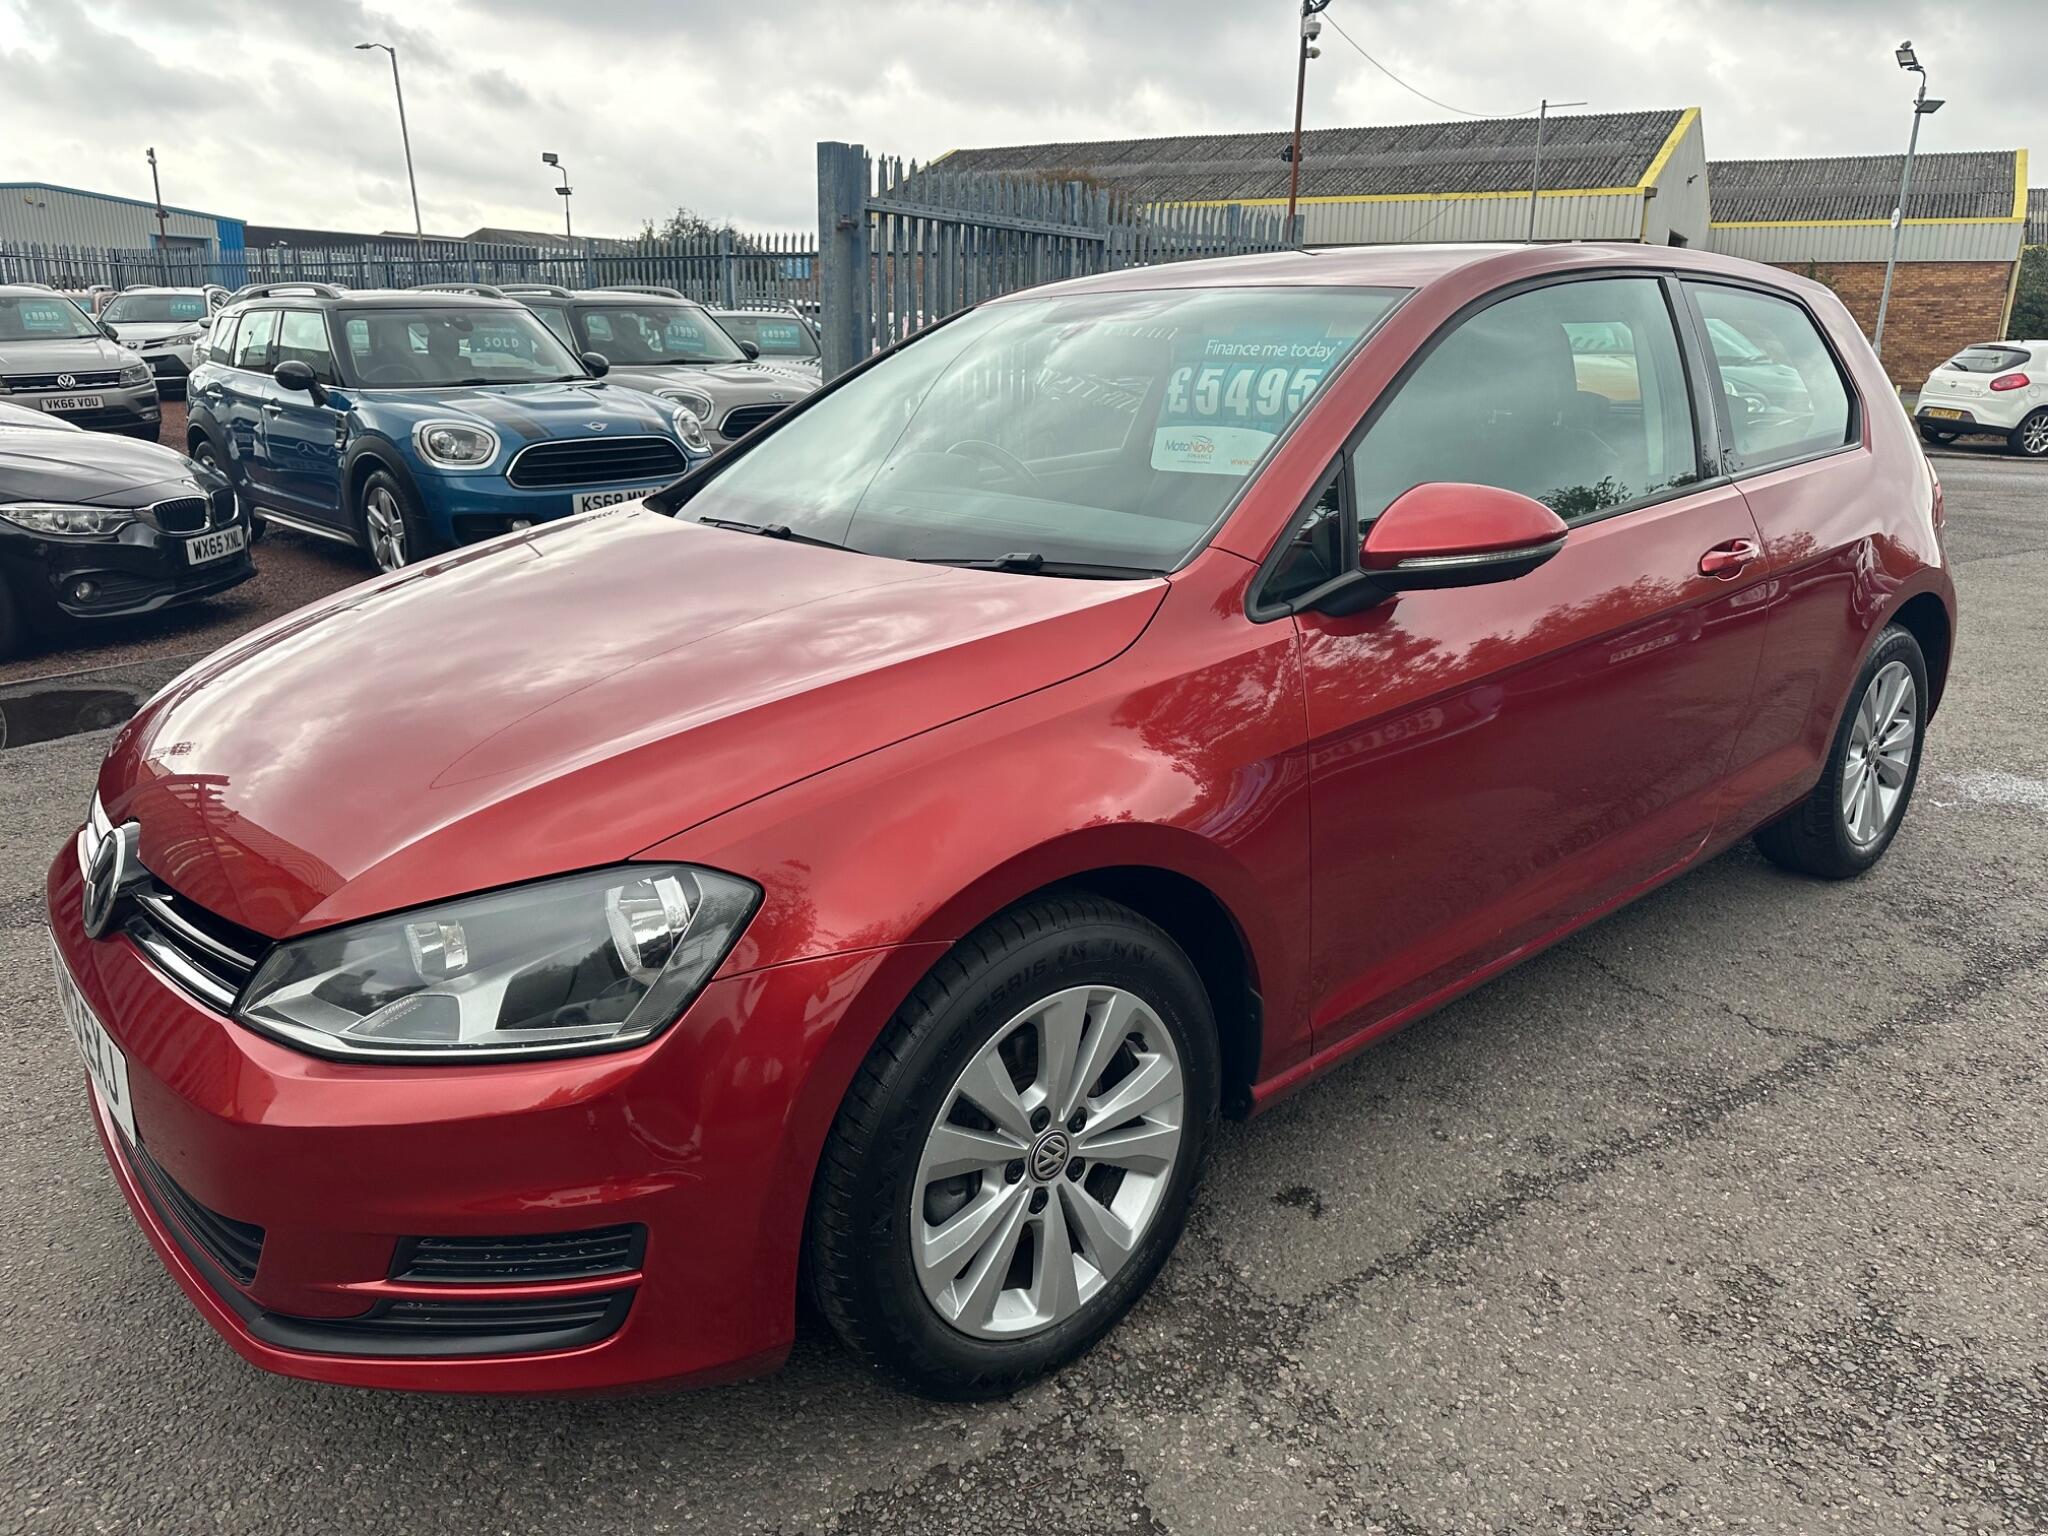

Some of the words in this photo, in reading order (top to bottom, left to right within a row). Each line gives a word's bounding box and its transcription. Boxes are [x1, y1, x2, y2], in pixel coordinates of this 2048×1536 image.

[484, 337, 519, 348] SOLD
[1204, 340, 1260, 356] Finance
[1262, 344, 1288, 356] me
[1167, 367, 1322, 416] £5495
[46, 398, 75, 409] VK66
[77, 397, 99, 407] VOU
[193, 535, 223, 560] WX65
[224, 530, 242, 551] XNL
